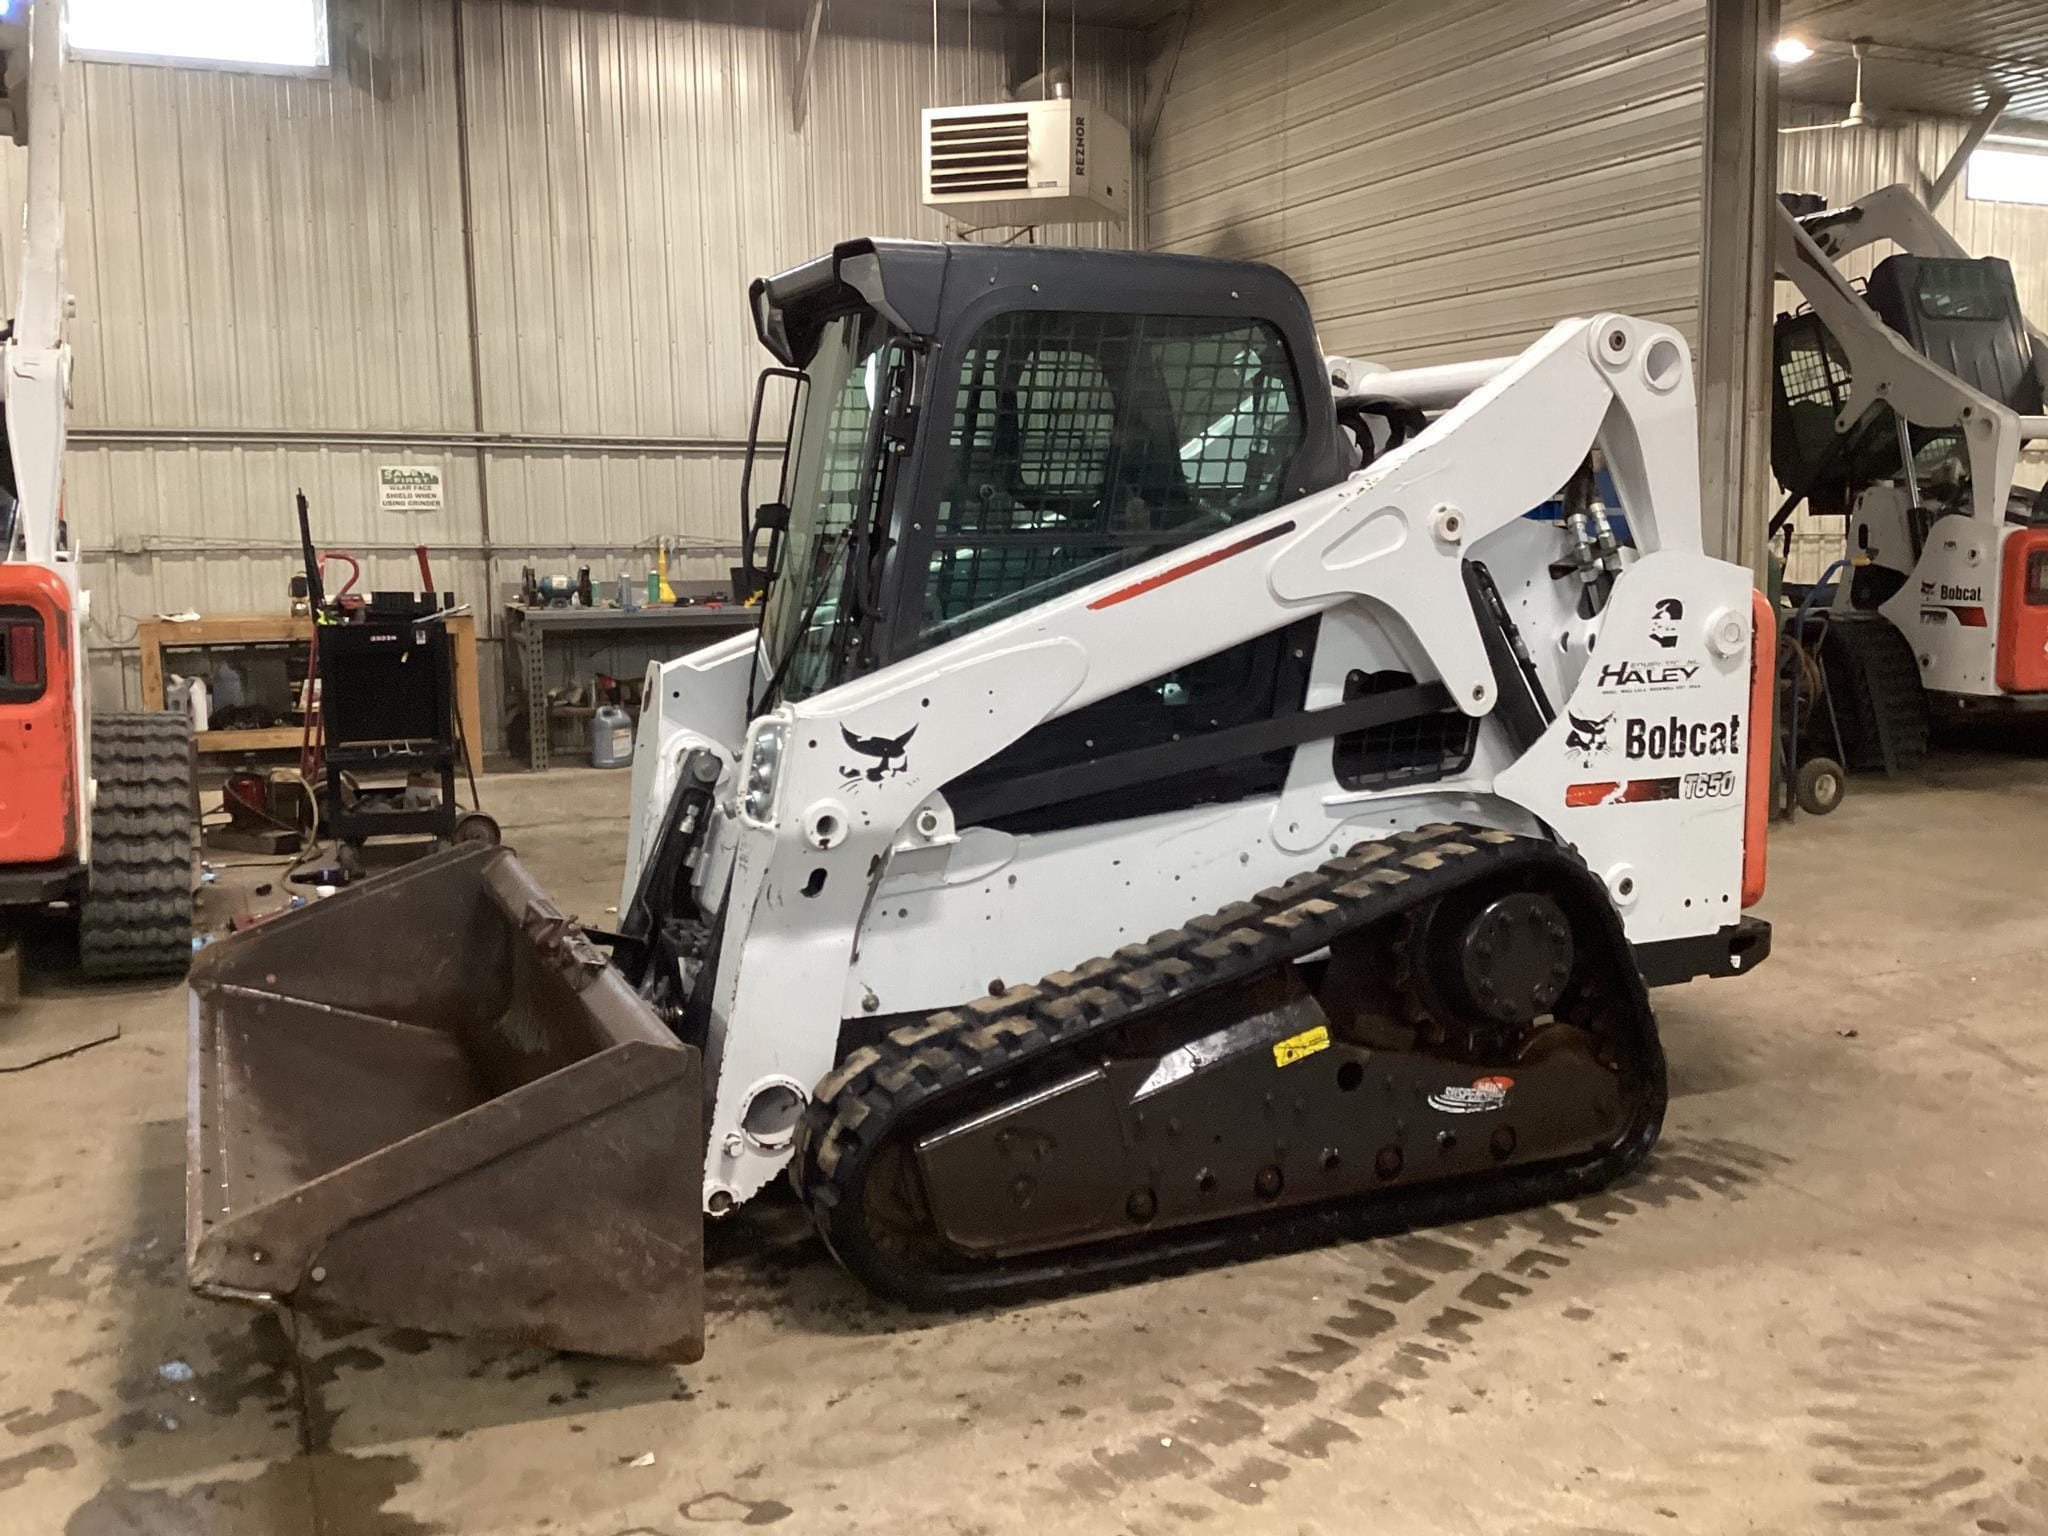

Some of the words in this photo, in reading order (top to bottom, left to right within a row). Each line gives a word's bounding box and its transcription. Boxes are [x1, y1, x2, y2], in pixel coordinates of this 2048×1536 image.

[1076, 116, 1085, 176] REZNOR
[1940, 584, 1982, 601] Bobcat
[1597, 661, 1700, 687] HALEY
[1625, 714, 1741, 760] Bobcat
[1683, 771, 1736, 799] T650
